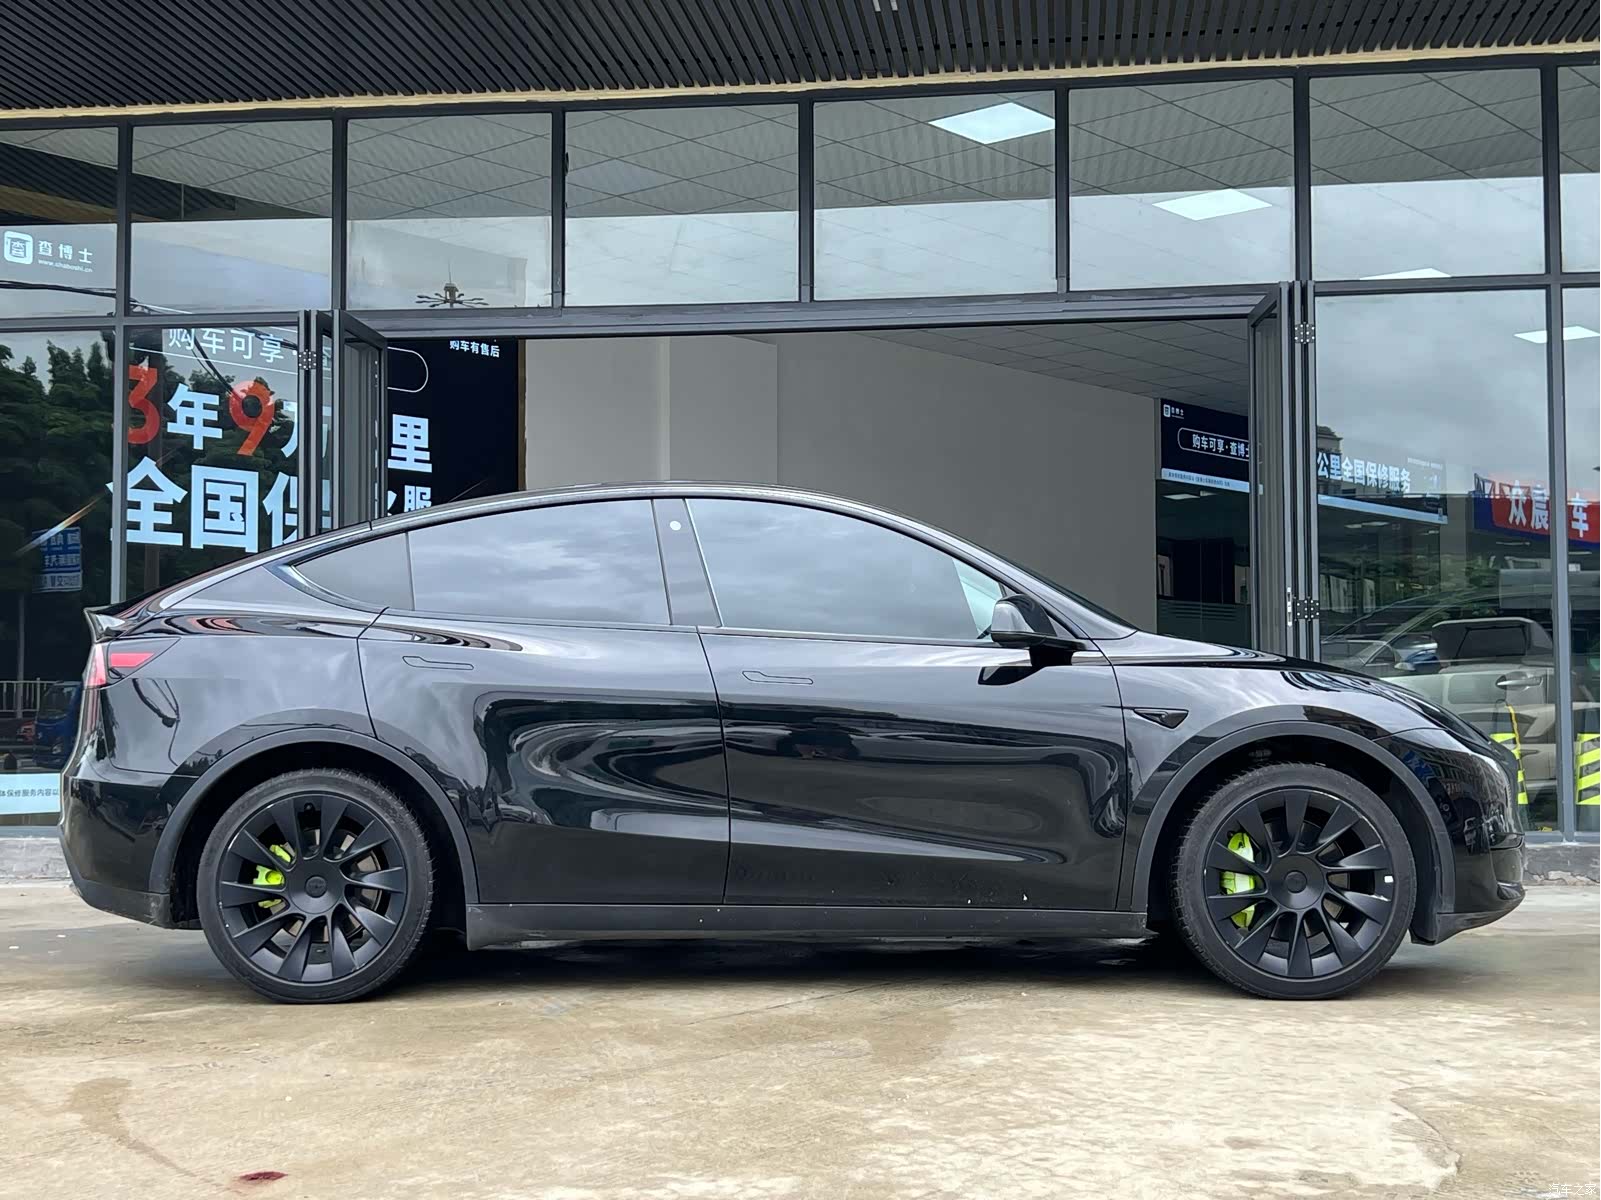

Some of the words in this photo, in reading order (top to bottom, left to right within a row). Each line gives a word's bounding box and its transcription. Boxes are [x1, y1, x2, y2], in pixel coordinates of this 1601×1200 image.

[38, 240, 93, 264] 查博士
[450, 339, 500, 358] 购车有售后
[1317, 451, 1411, 493] 公里全国保修服务
